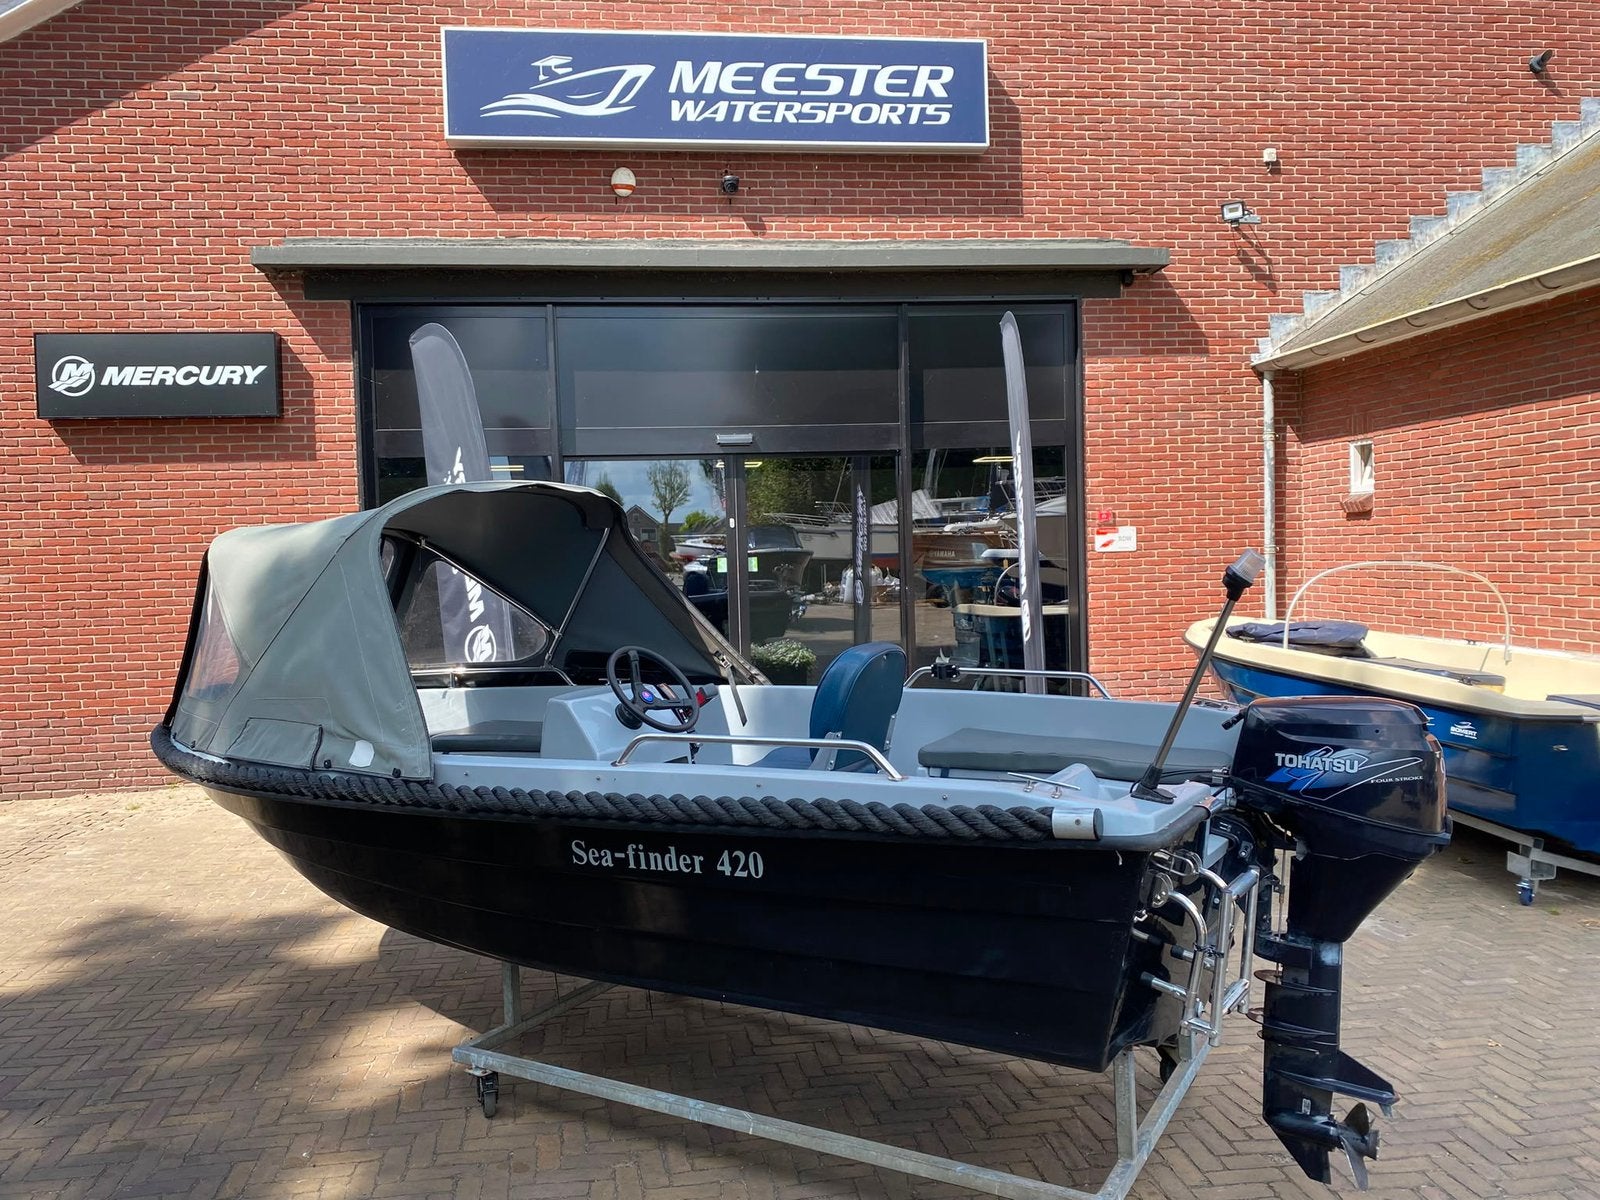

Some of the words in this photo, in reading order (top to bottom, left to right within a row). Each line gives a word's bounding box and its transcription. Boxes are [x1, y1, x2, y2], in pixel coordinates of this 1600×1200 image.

[668, 60, 955, 98] MEESTER
[670, 99, 953, 125] WATERSPORTS
[100, 365, 267, 386] MERCURY
[1275, 752, 1359, 774] TOHATSU
[571, 839, 704, 874] Sea-finder
[716, 849, 764, 879] 420
